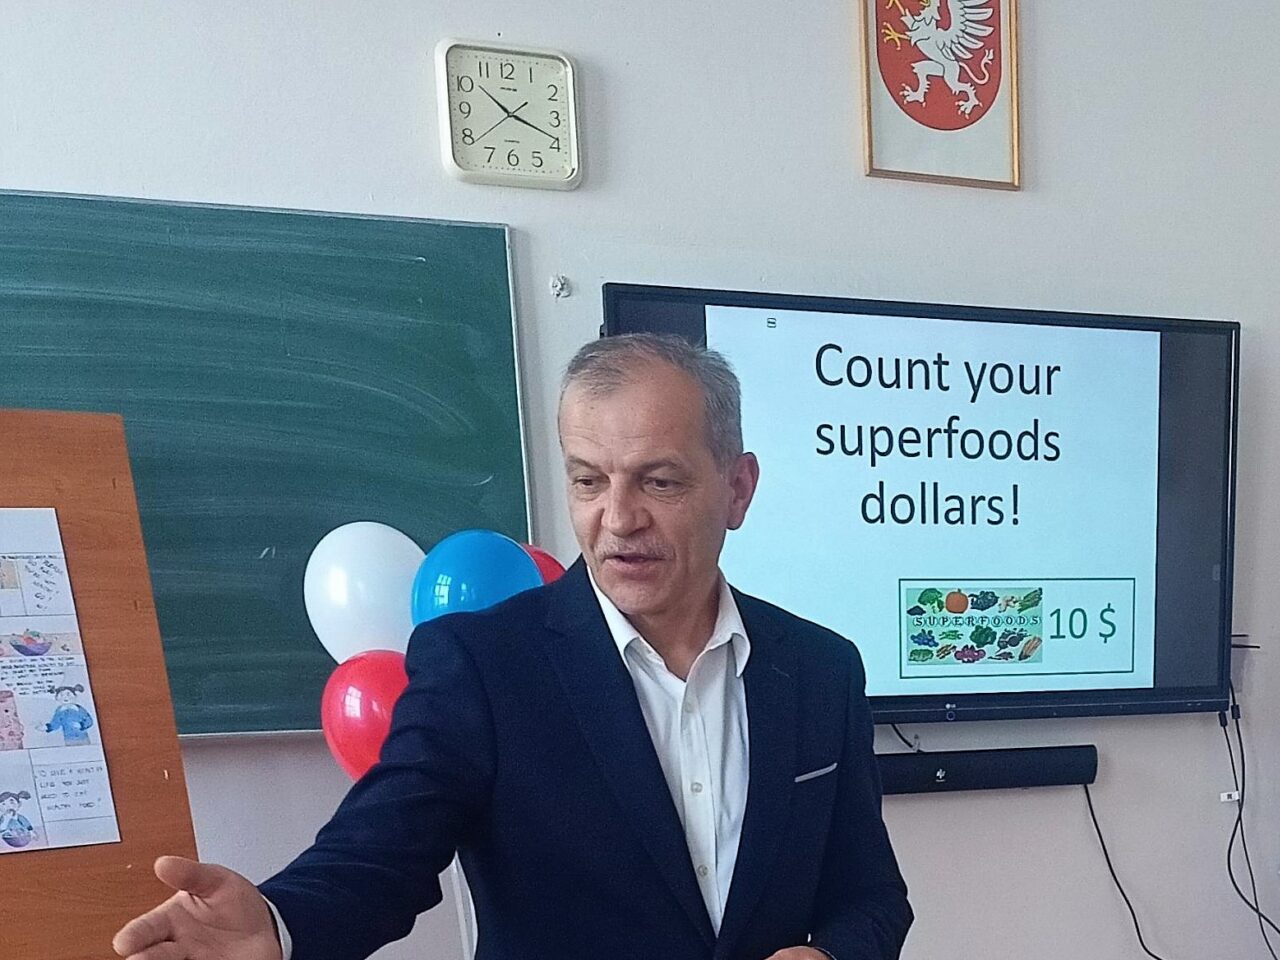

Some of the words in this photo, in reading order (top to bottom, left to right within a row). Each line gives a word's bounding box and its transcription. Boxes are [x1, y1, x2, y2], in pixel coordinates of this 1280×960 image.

[478, 61, 490, 78] 11
[500, 62, 515, 80] 12
[457, 75, 474, 93] 10
[547, 84, 559, 102] 2
[459, 101, 472, 119] 9
[549, 110, 561, 128] 3
[462, 128, 475, 146] 8
[549, 137, 561, 152] 4
[483, 146, 496, 163] 7
[507, 149, 520, 167] 6
[531, 151, 544, 168] 5
[814, 343, 950, 391] Count
[964, 361, 1061, 404] your
[815, 416, 1061, 467] superfoods
[860, 481, 1020, 526] dollars!
[913, 615, 1040, 627] SUPERFOODS
[1049, 607, 1088, 640] 10
[1099, 602, 1117, 644] $
